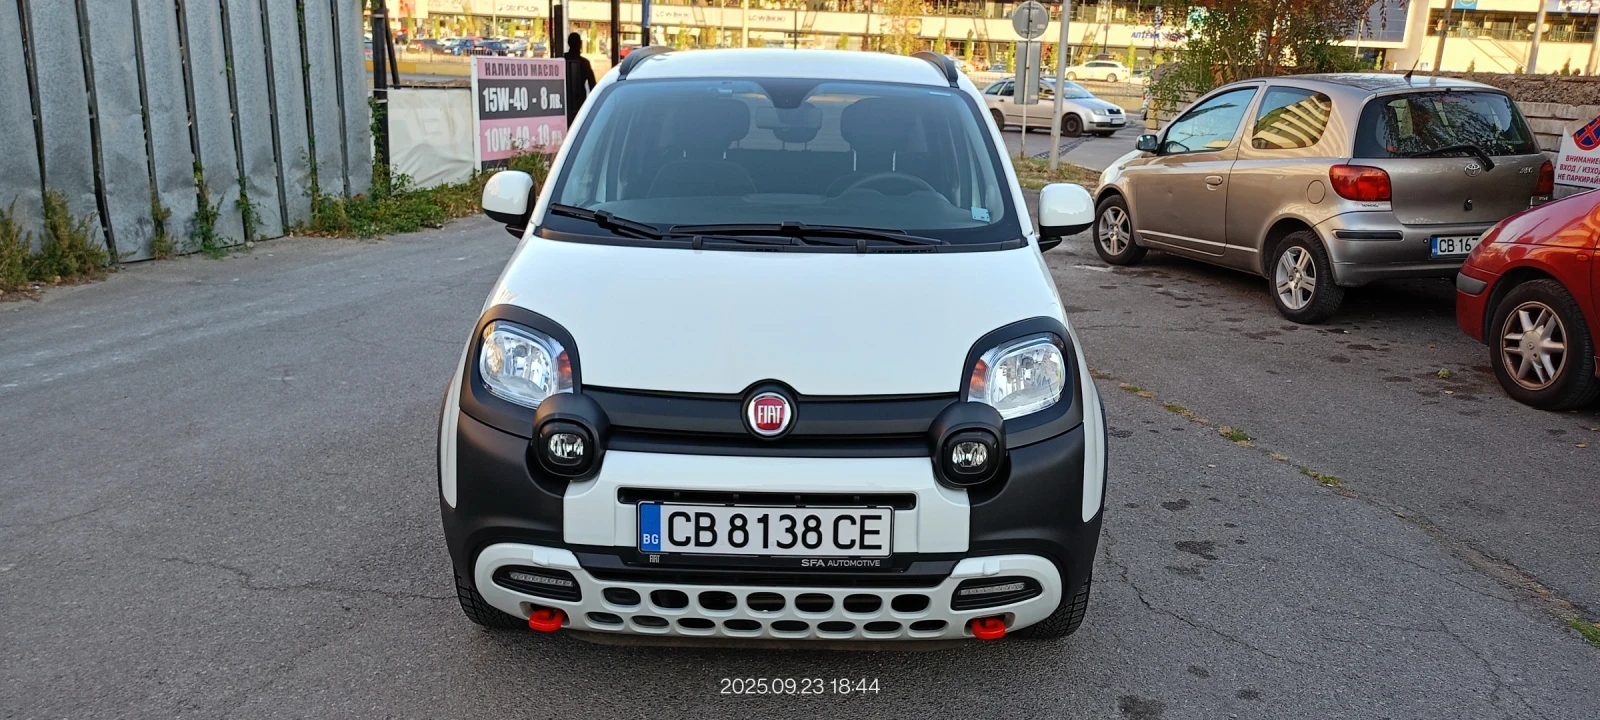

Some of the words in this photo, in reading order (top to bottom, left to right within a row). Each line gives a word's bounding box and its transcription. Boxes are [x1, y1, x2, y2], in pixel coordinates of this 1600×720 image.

[484, 62, 528, 76] НАЛИВНО
[530, 64, 559, 76] МАСЛО
[482, 87, 528, 112] 15W-40
[540, 87, 548, 110] 8
[1559, 164, 1576, 173] ВХОД
[757, 405, 783, 424] FIAT
[668, 511, 718, 547] CB
[728, 513, 823, 549] 8138
[833, 514, 882, 550] CE
[643, 534, 659, 545] BG
[801, 559, 826, 567] SFA
